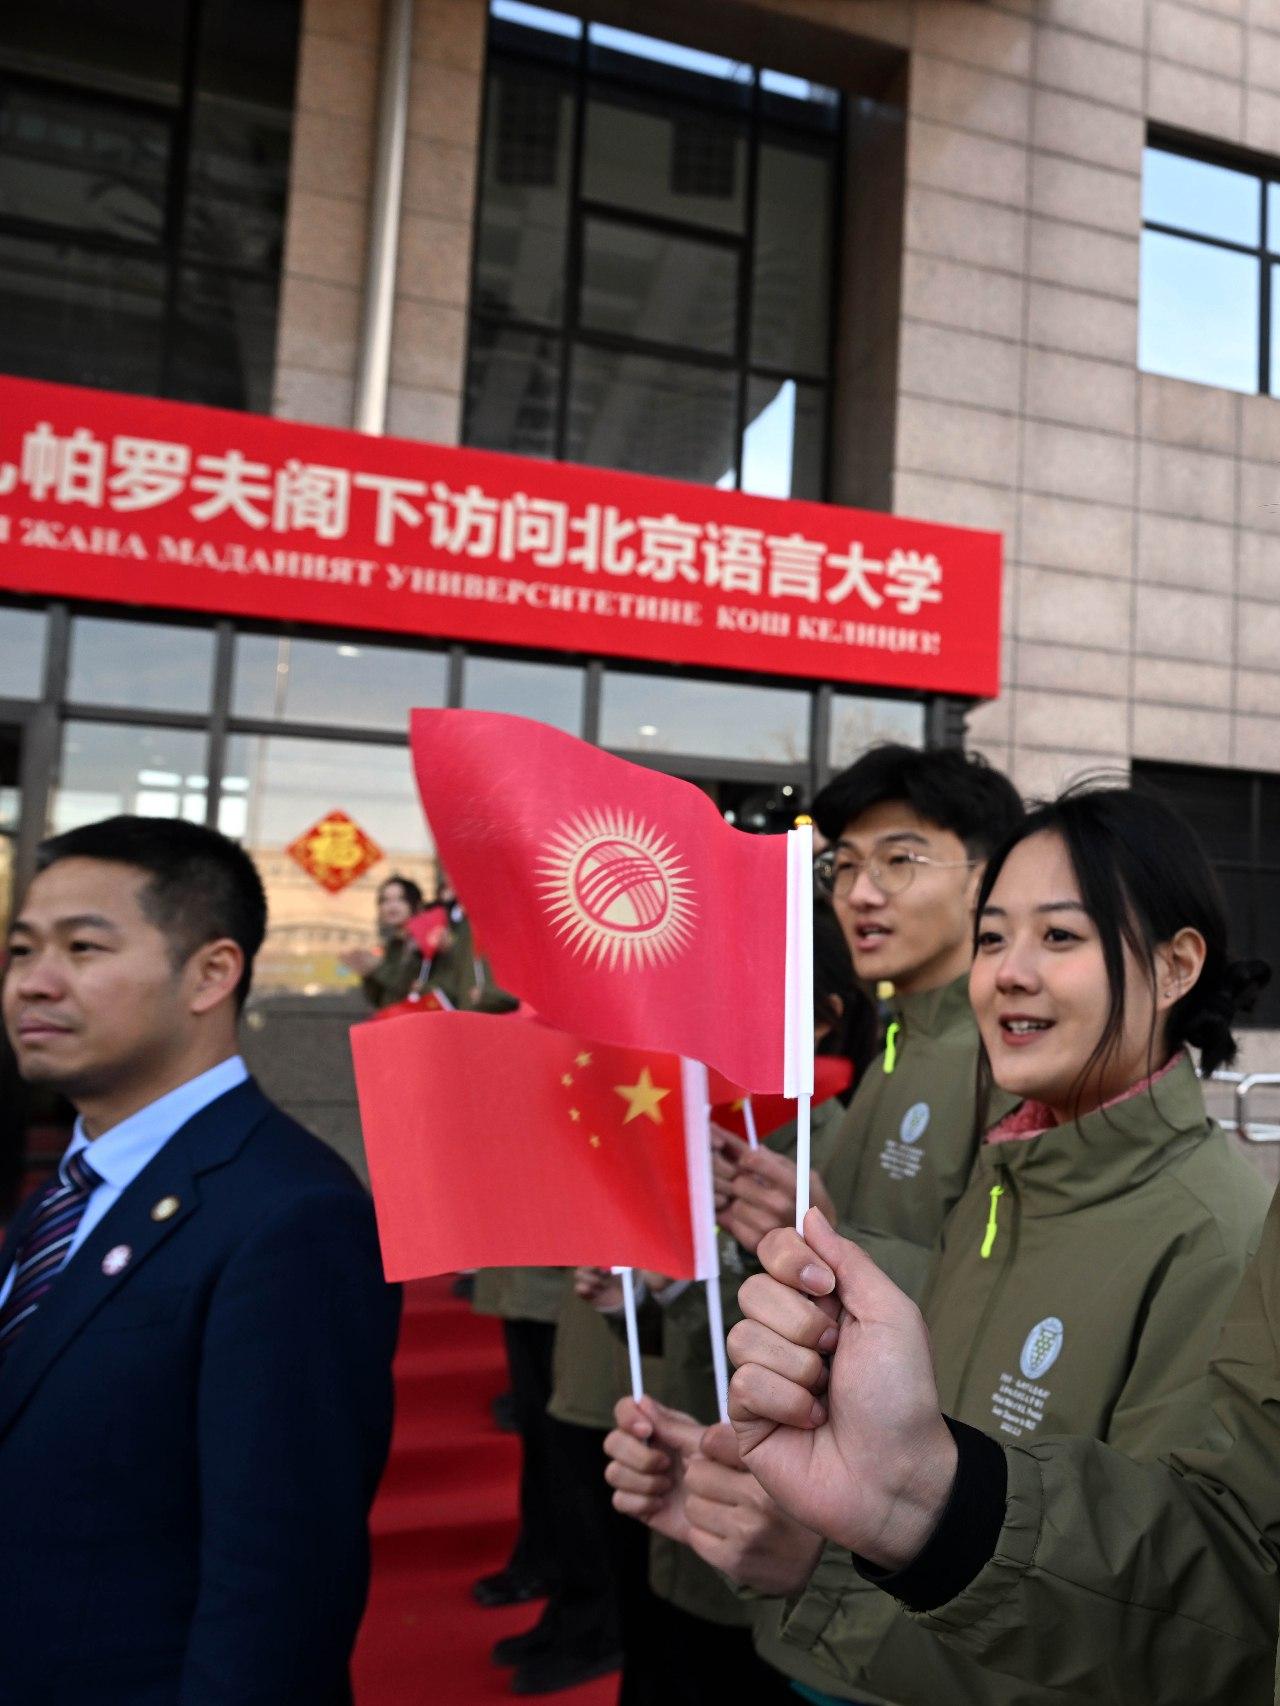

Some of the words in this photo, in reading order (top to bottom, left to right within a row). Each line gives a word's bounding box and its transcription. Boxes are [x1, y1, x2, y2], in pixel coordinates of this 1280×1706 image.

[0, 421, 943, 615] 帕罗夫阁下访问北京语言大学
[19, 516, 149, 561] ЖАНА
[156, 533, 380, 588] МАДАНИЯТ
[716, 604, 791, 638] КОШ
